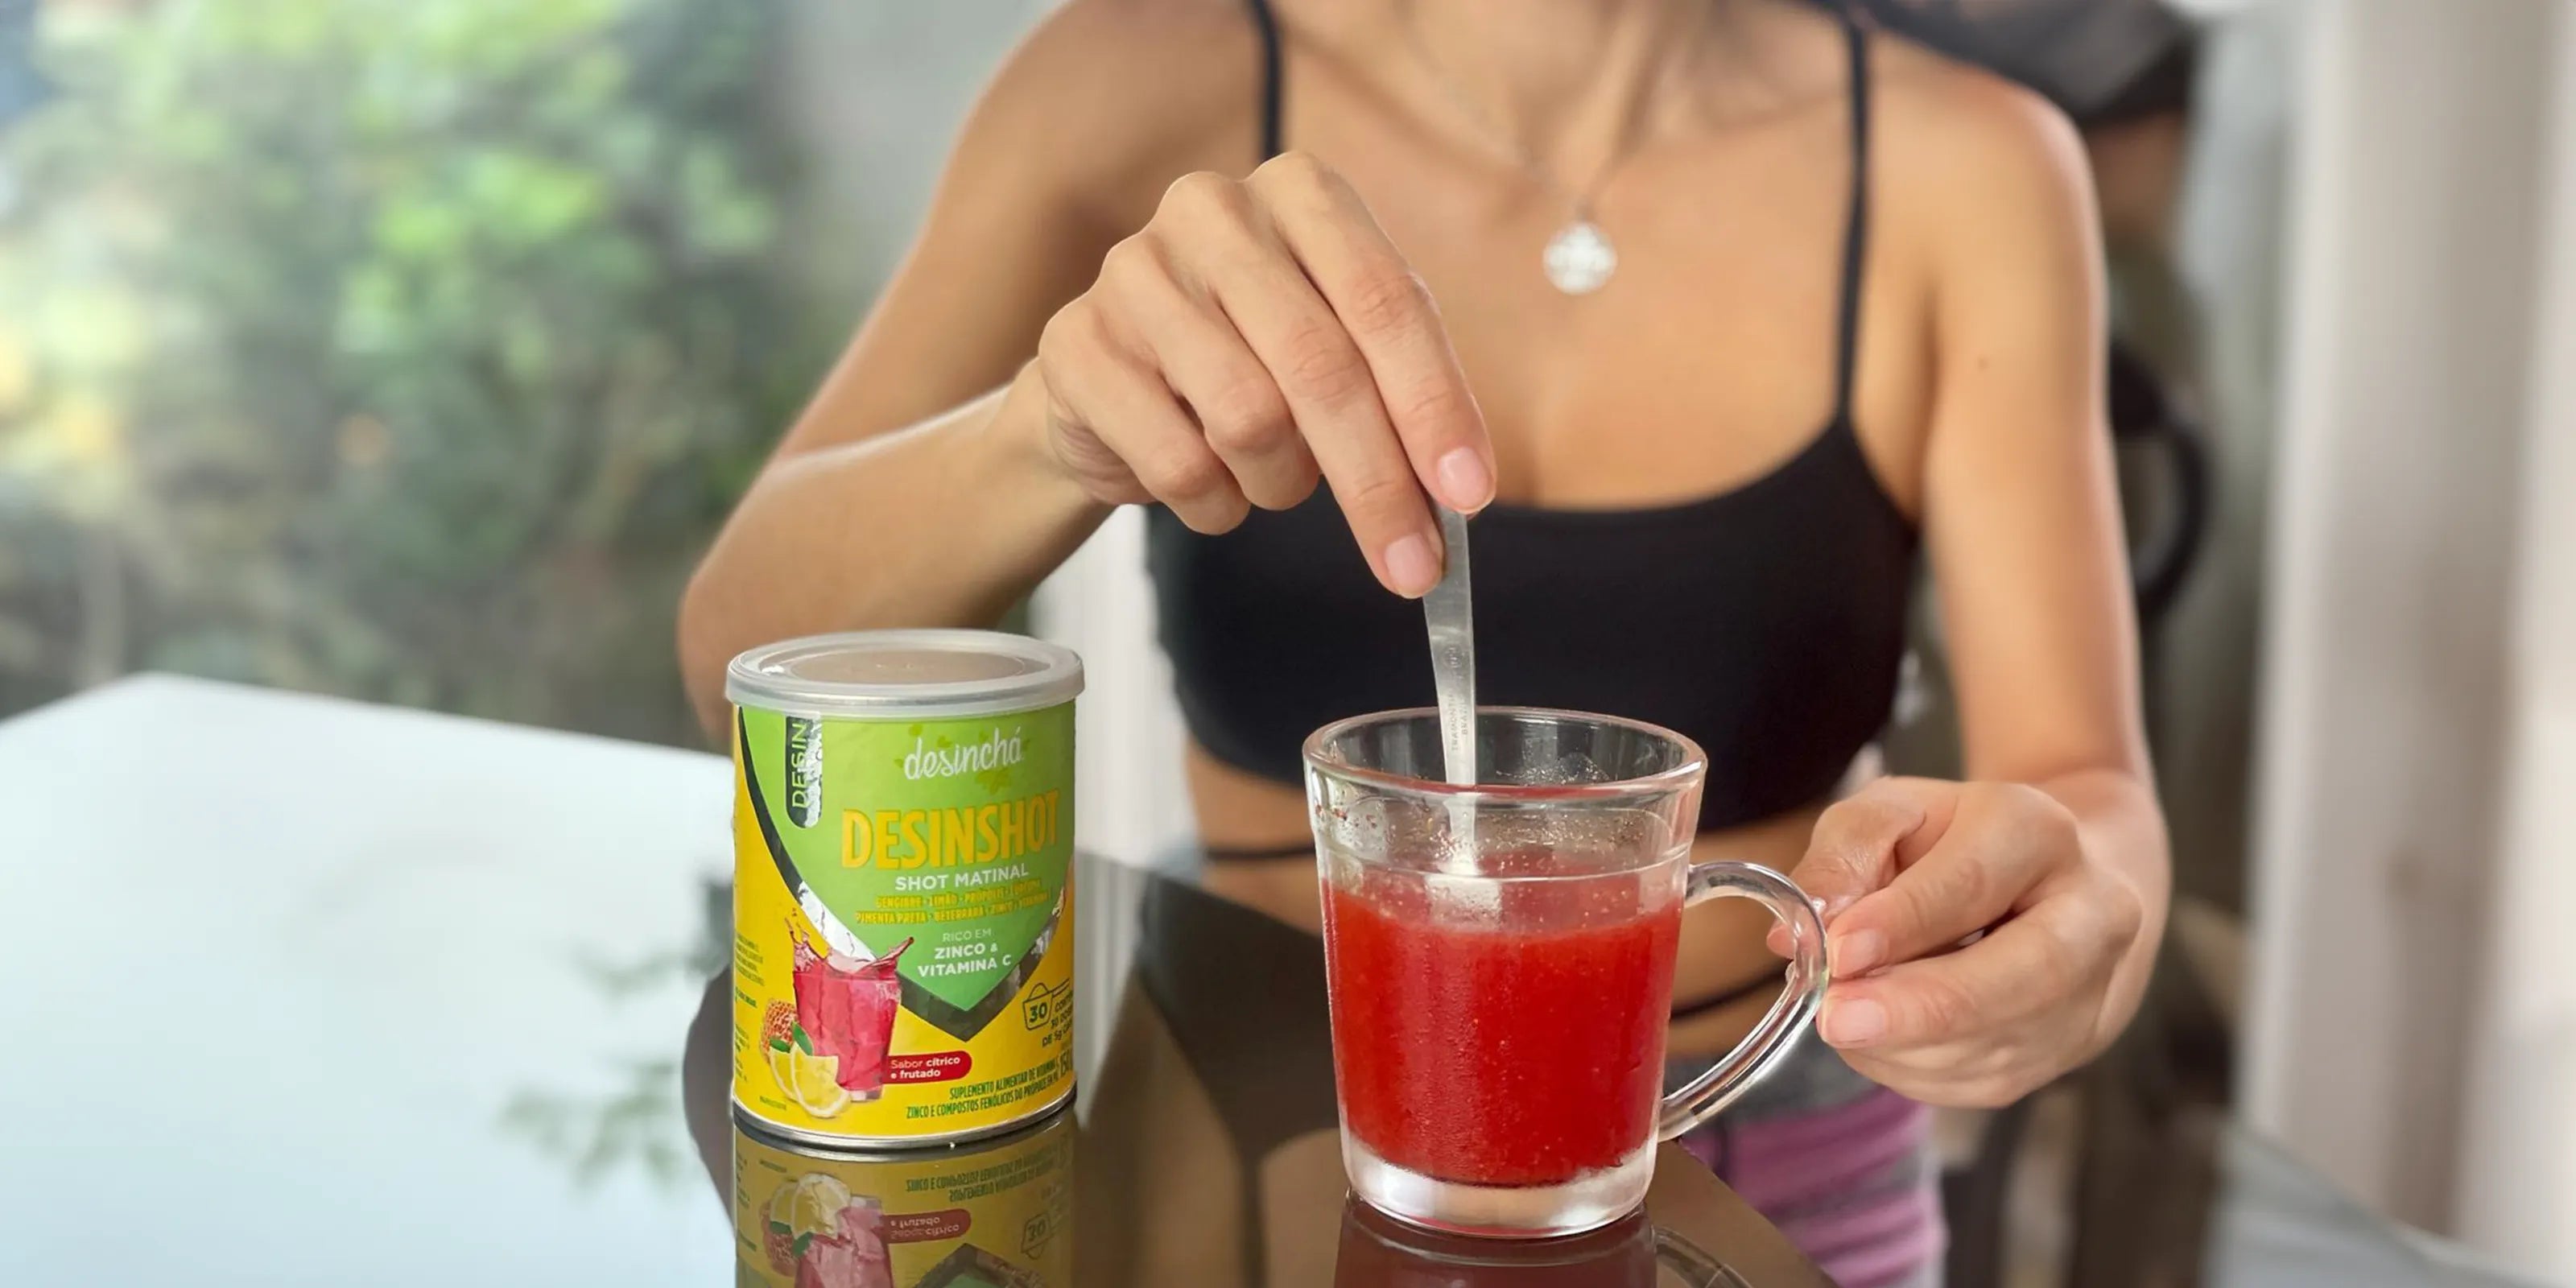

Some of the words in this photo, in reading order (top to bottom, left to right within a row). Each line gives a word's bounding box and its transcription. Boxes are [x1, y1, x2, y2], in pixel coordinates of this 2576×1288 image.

[904, 726, 1022, 780] desinchá
[791, 723, 811, 809] DESIN
[841, 789, 1060, 870] DESINSHOT
[894, 874, 949, 892] SHOT
[955, 863, 1030, 888] MATINAL
[942, 931, 972, 943] RICO
[975, 928, 992, 939] EM
[934, 943, 986, 960] ZINCO
[990, 943, 998, 952] &
[917, 957, 998, 978] VITAMINA
[1002, 954, 1012, 966] C
[1029, 1002, 1048, 1023] 30
[890, 1059, 923, 1070] Sabor
[926, 1056, 960, 1067] cítrico
[899, 1069, 941, 1080] frutado
[949, 1083, 995, 1100] SUPLEMENTO
[906, 1105, 929, 1119] ZINCO
[931, 1105, 935, 1117] E
[936, 1100, 979, 1117] COMPOSTOS
